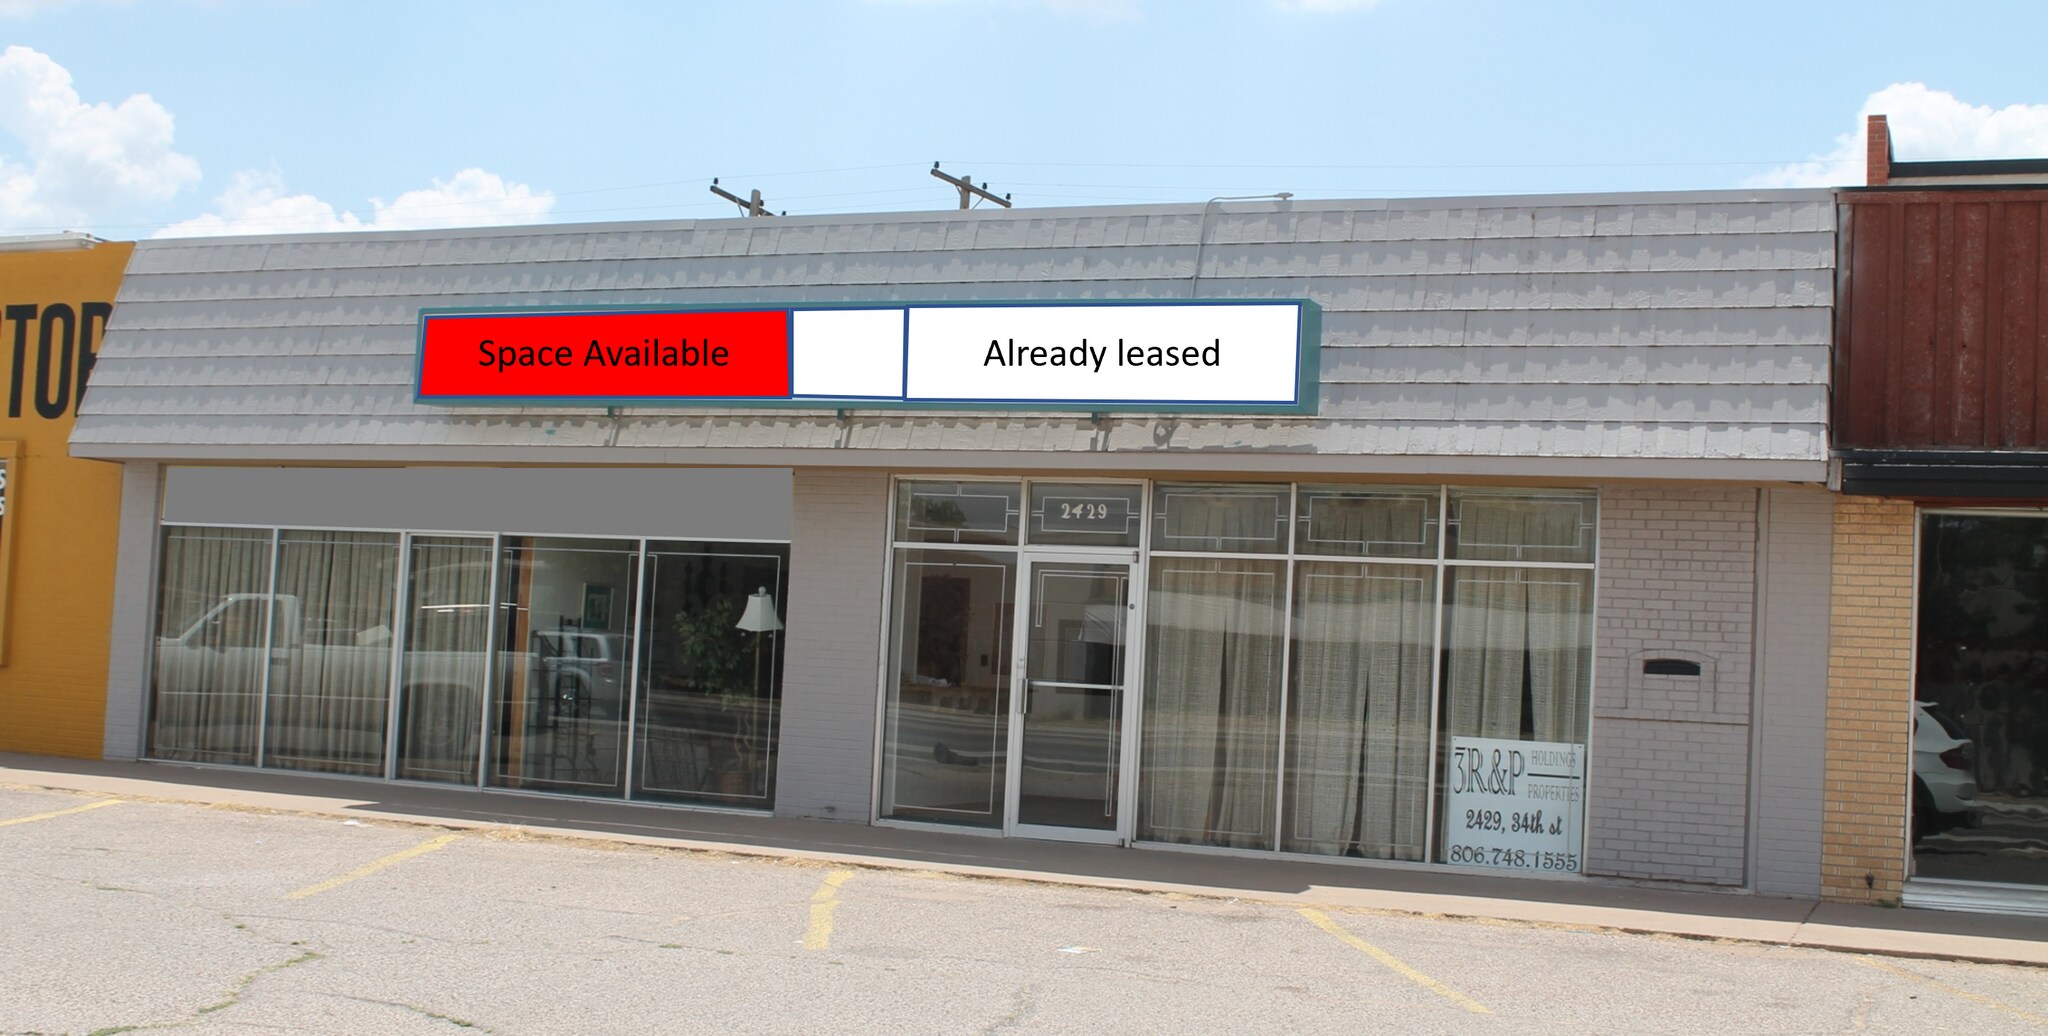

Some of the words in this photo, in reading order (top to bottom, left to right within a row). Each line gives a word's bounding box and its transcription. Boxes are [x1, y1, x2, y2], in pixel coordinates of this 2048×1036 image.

[1061, 503, 1107, 519] 2429
[1531, 750, 1576, 768] HOLDINGS
[1527, 784, 1580, 802] PROPERTIES
[1465, 809, 1506, 834] 2429,
[1511, 810, 1544, 834] 34th
[1549, 815, 1563, 835] st
[1450, 844, 1577, 871] 806.748.1555
